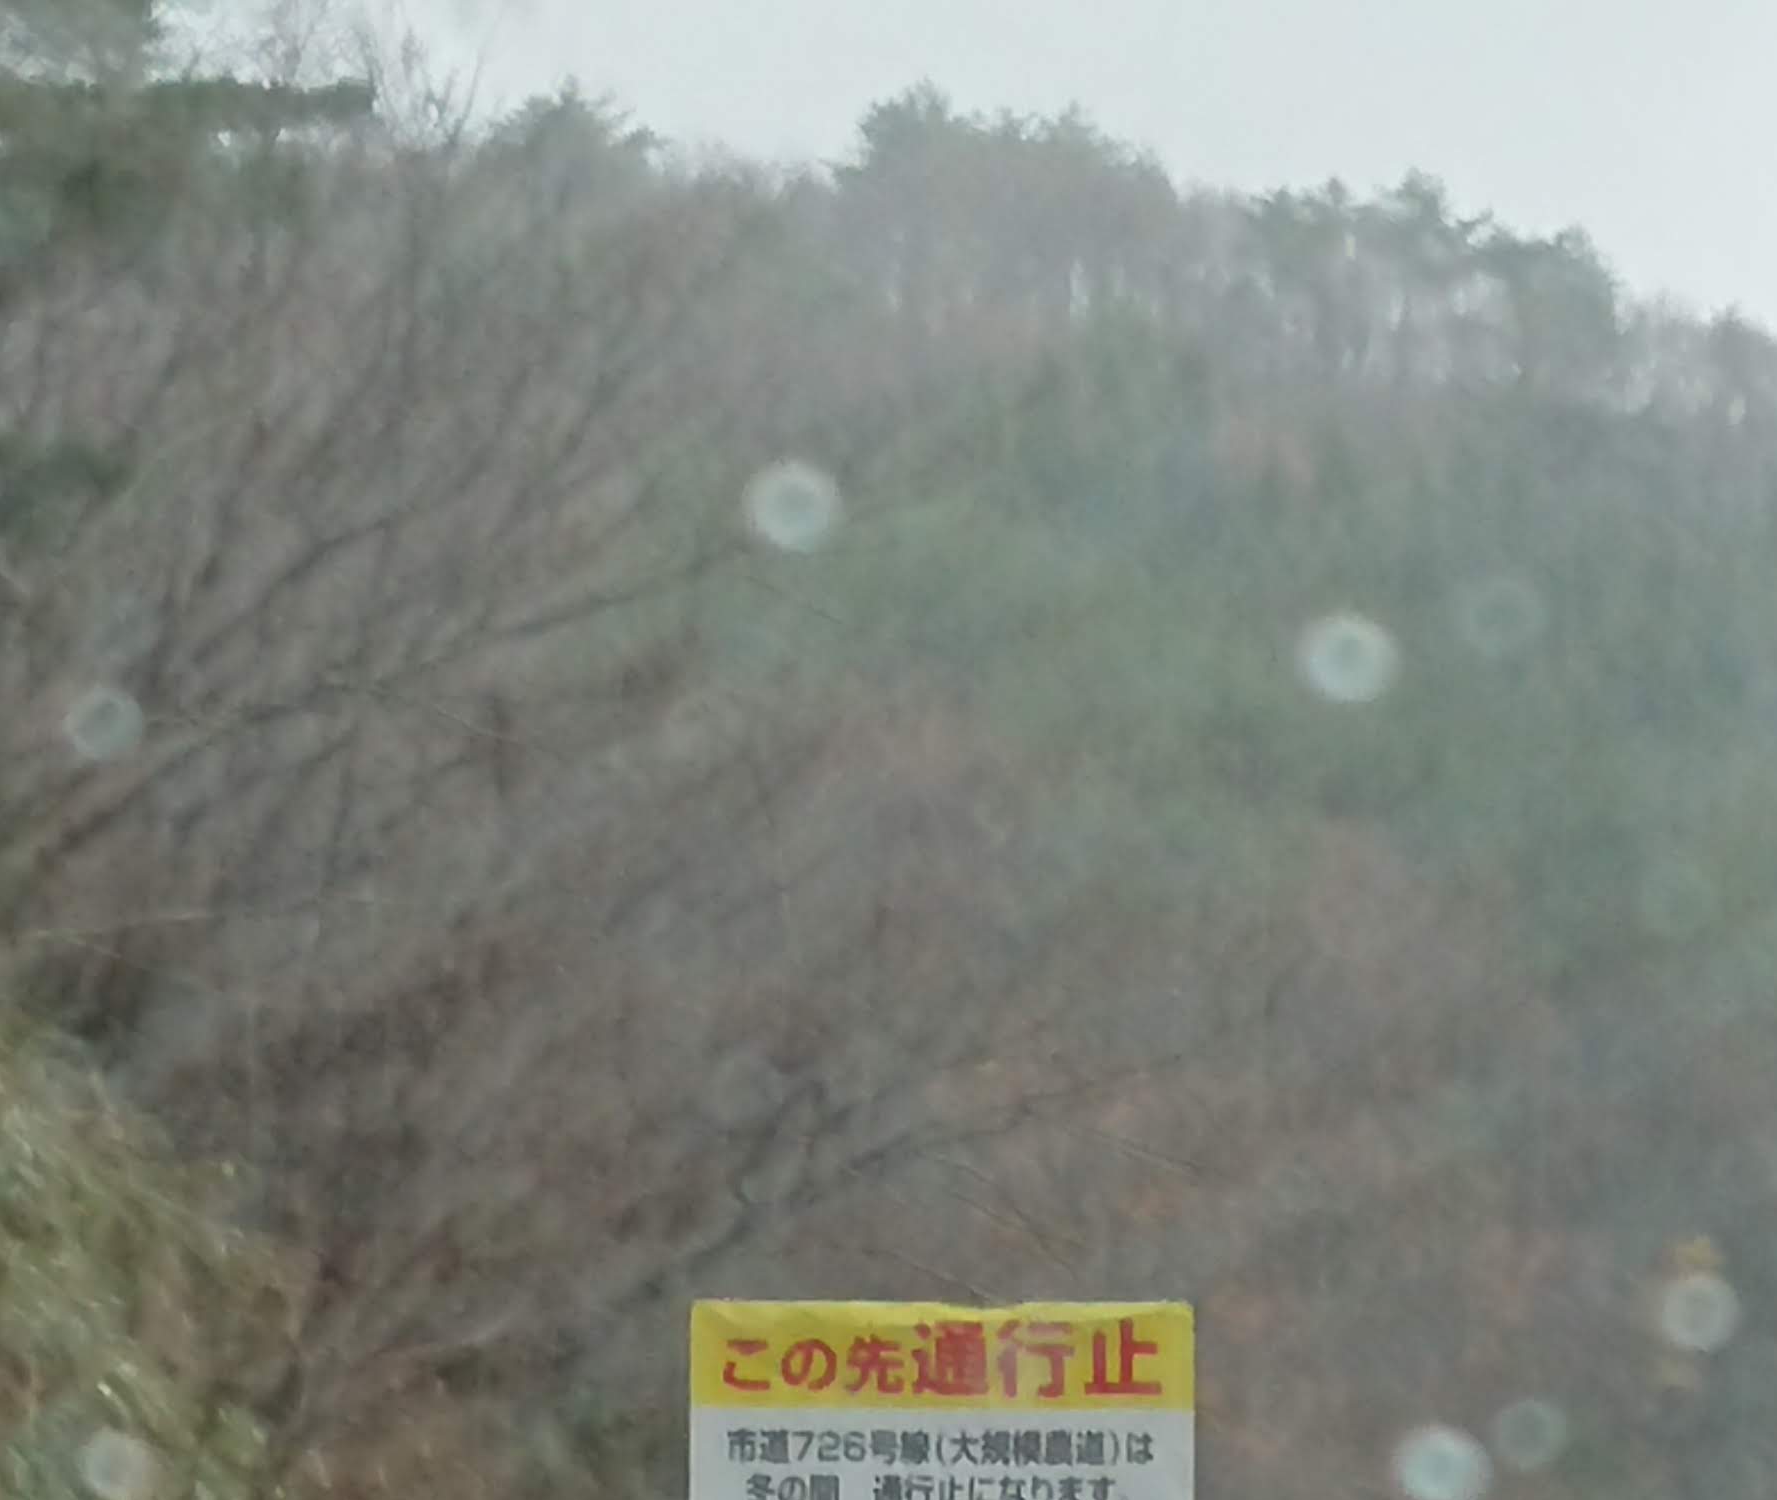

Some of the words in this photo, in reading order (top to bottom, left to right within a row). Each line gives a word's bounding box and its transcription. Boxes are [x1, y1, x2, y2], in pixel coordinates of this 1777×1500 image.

[723, 1318, 1161, 1398] この先通行止
[726, 1428, 1154, 1466] 市道726号線(大規模農道)は
